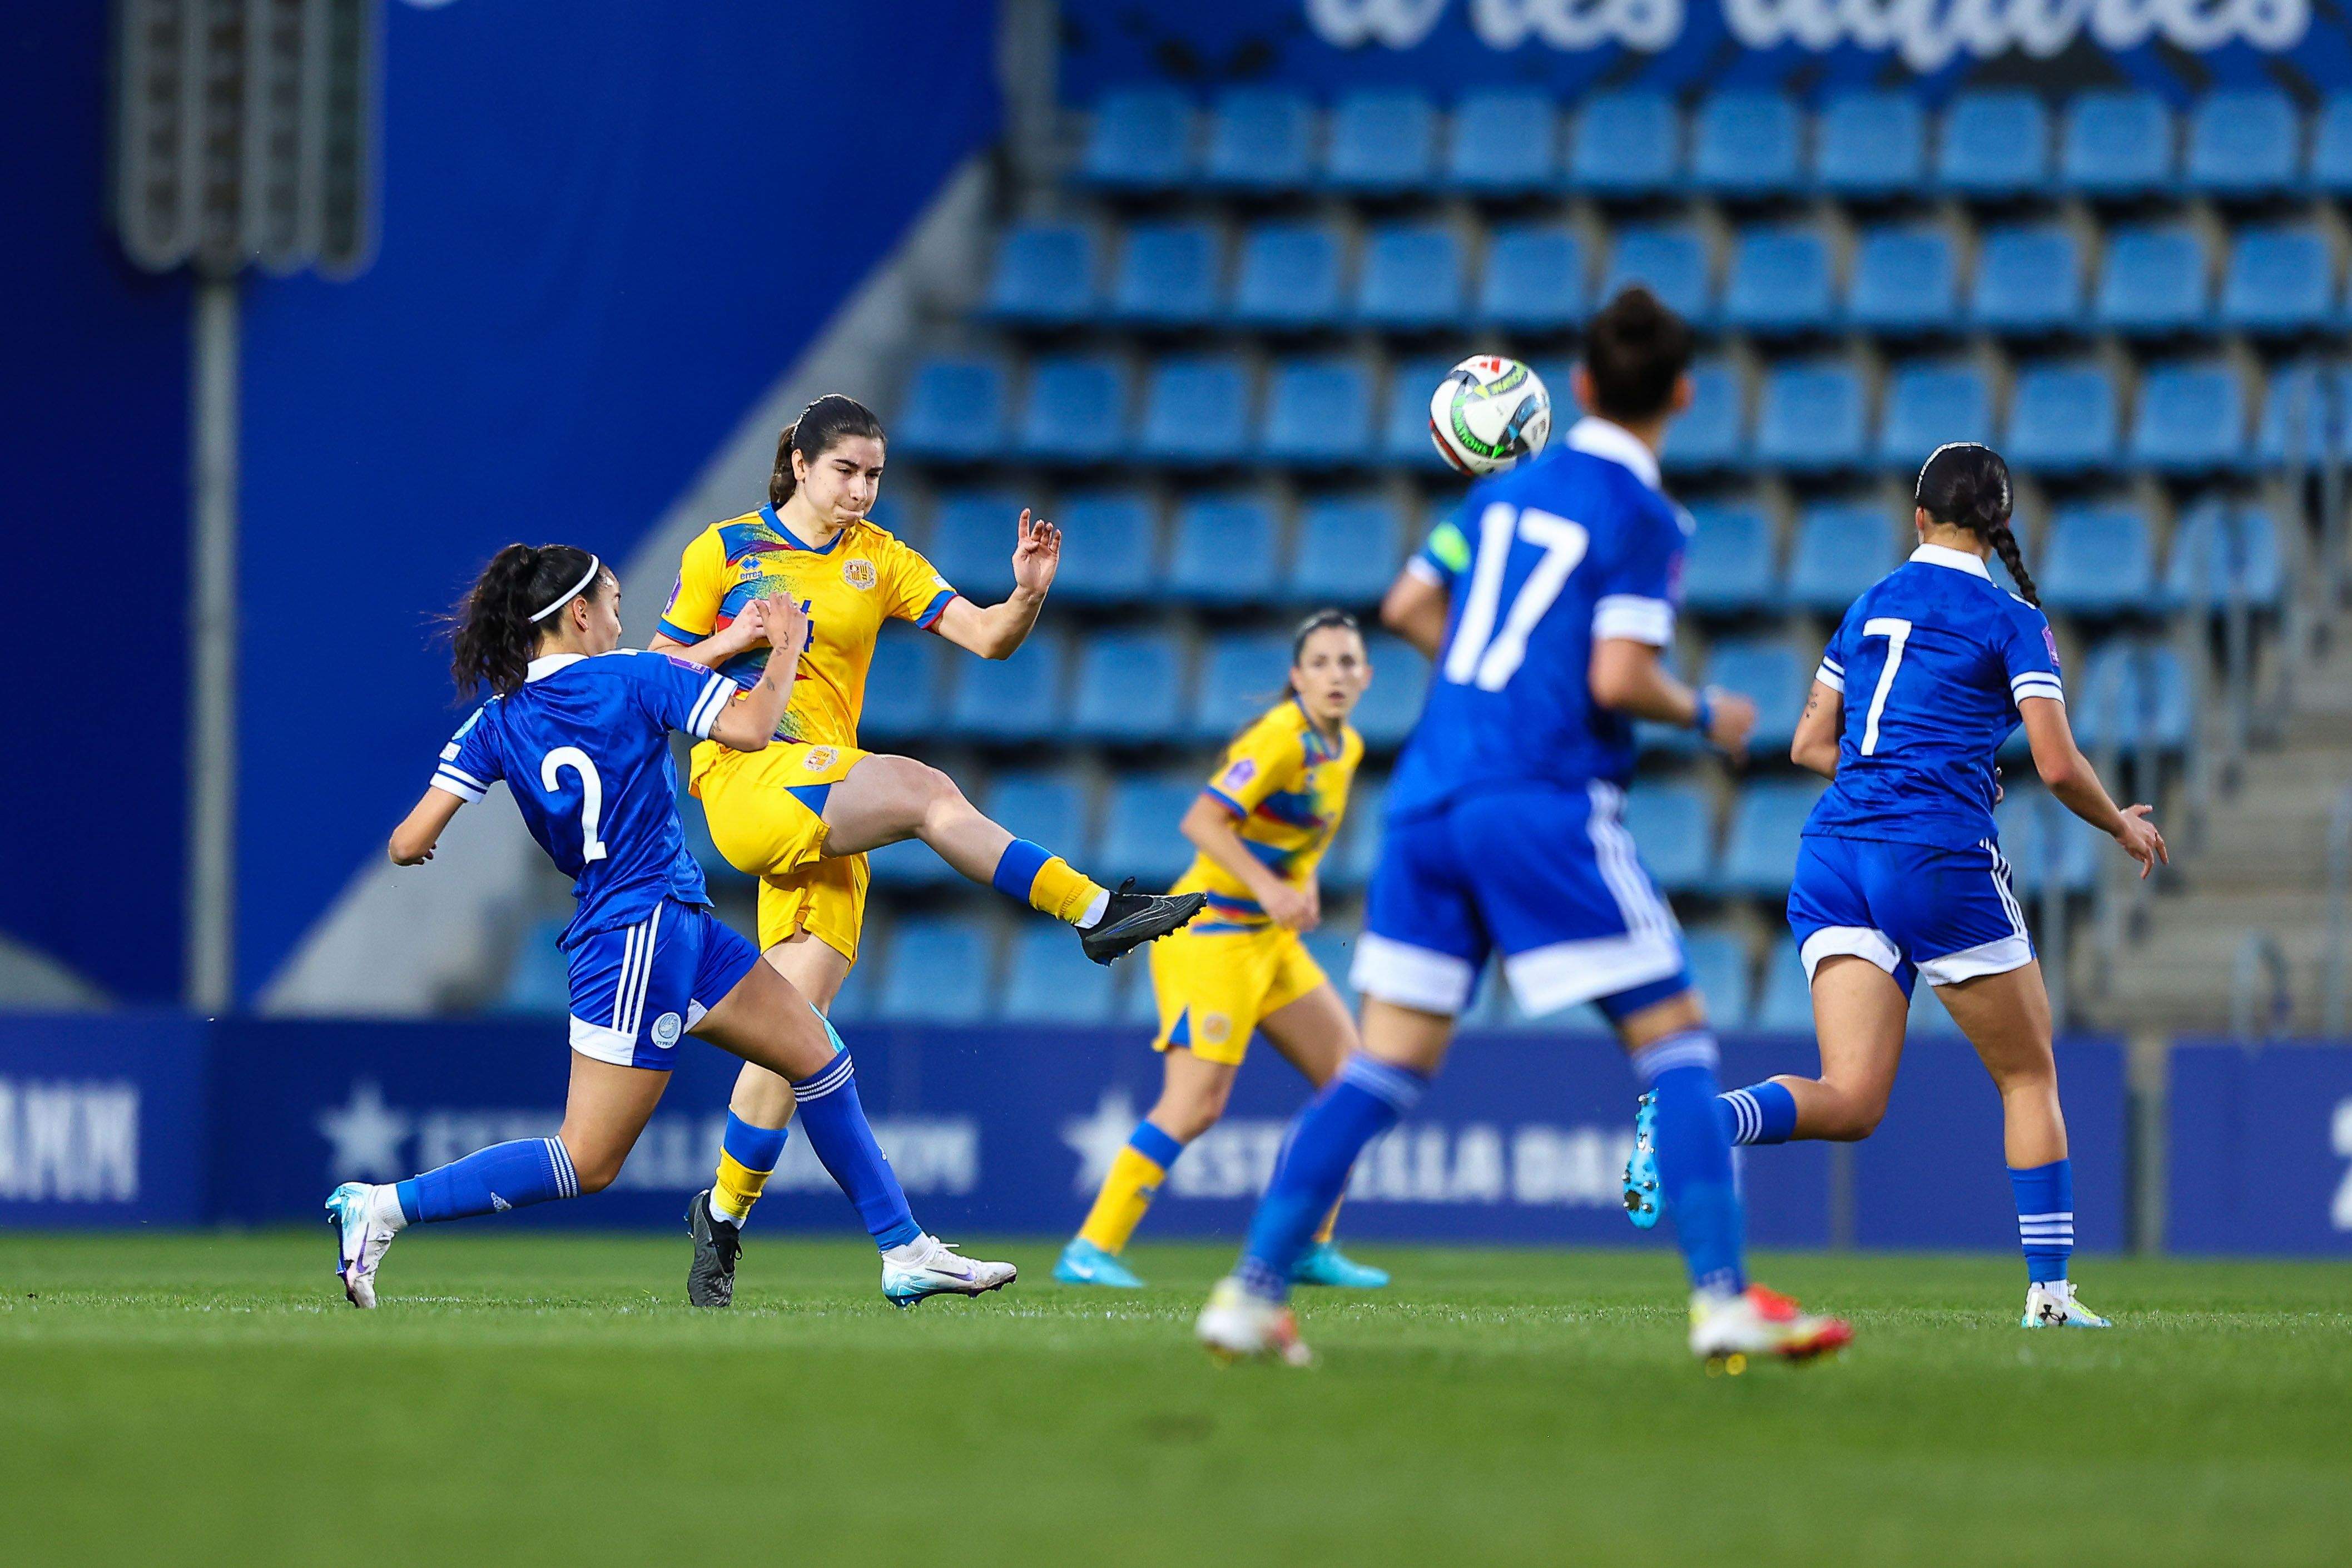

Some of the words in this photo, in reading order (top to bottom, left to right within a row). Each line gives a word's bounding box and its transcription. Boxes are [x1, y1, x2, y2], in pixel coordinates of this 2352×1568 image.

[1445, 500, 1590, 693] 17
[1863, 617, 1913, 756] 7
[541, 746, 607, 864] 2
